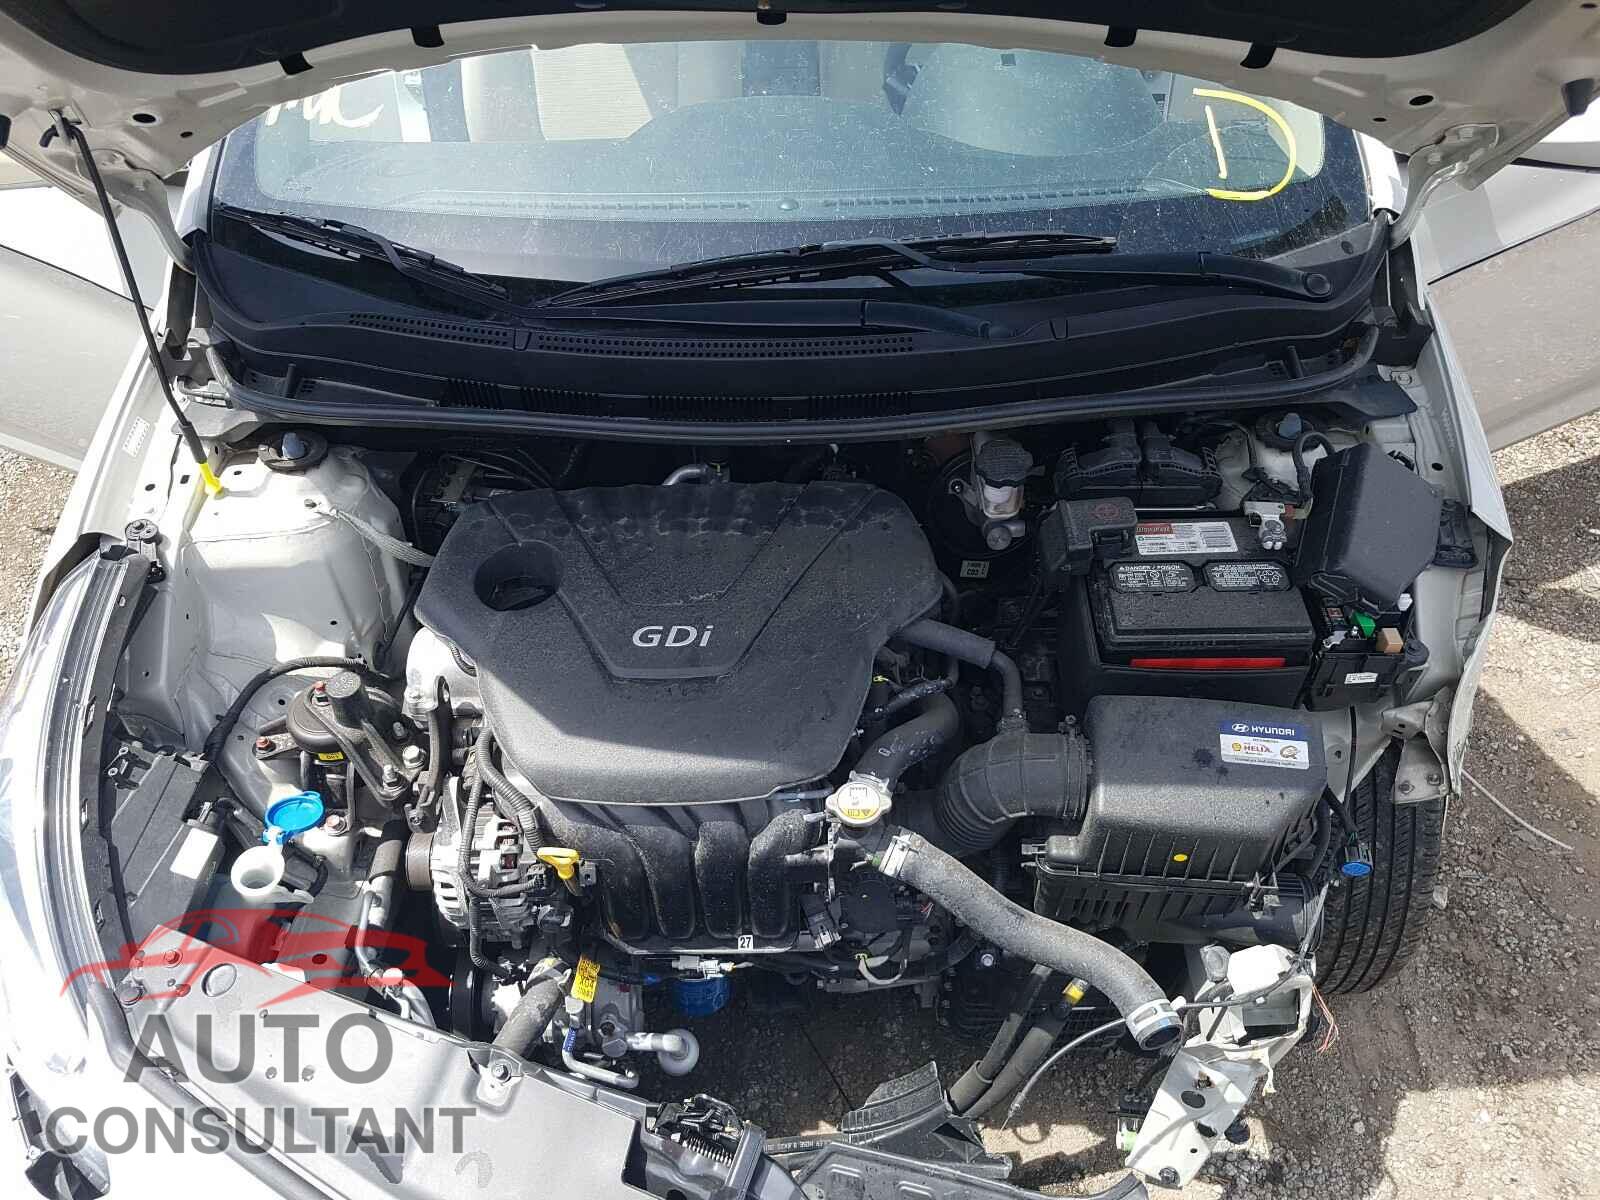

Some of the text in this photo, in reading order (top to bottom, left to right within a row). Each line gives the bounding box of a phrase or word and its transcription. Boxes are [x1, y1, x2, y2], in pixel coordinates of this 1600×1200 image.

[632, 625, 714, 647] GDi
[1251, 725, 1295, 737] HYUNDAI
[739, 936, 752, 949] 27
